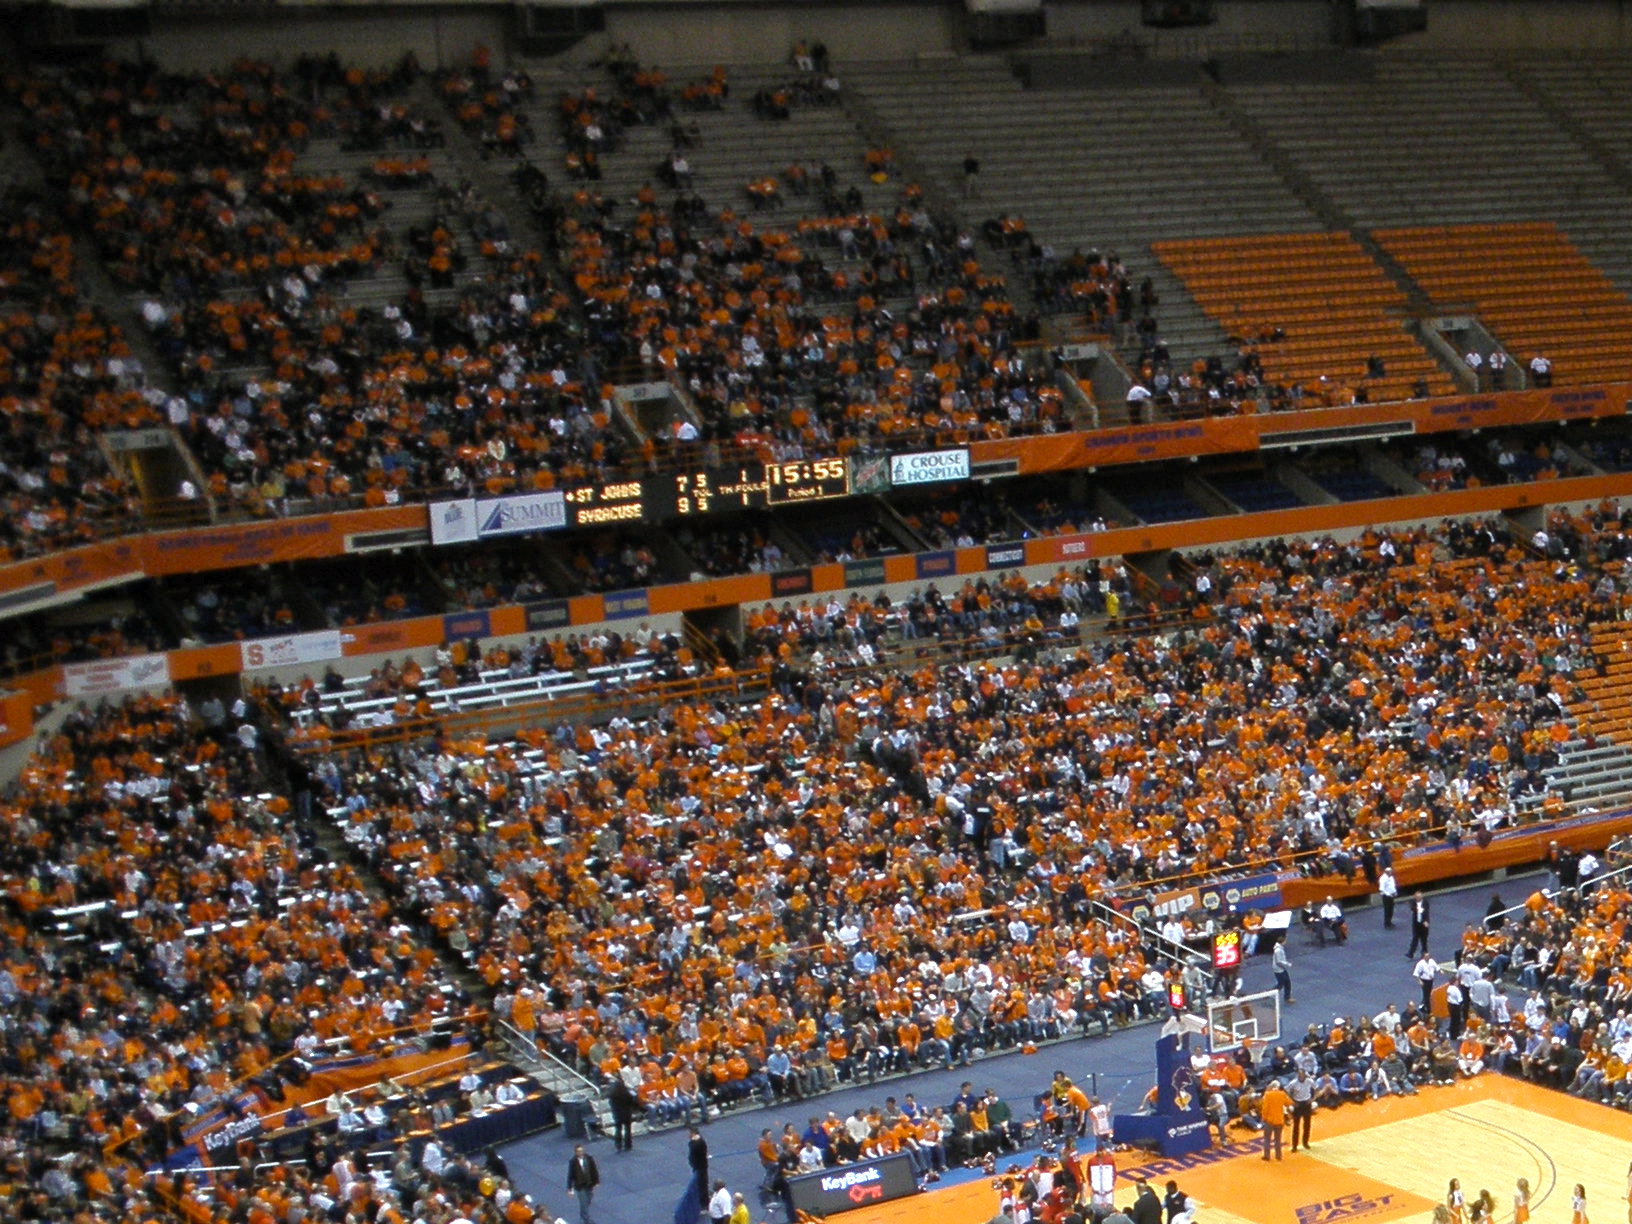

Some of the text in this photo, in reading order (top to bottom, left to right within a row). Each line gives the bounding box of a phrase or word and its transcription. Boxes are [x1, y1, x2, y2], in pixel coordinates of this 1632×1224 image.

[911, 453, 962, 469] CROUSE
[696, 474, 707, 488] 5
[773, 461, 844, 485] 15:55
[907, 466, 968, 482] HOSPITAL
[576, 483, 641, 502] ST JOHNS
[677, 476, 687, 492] 7
[501, 499, 564, 522] SUMMIT
[678, 497, 689, 513] 9
[698, 497, 708, 511] 5
[578, 504, 642, 524] SYRACUSE
[1153, 894, 1194, 917] VIP
[1216, 944, 1238, 965] 35
[821, 1167, 880, 1191] KeyBank
[1295, 1193, 1362, 1217] BIG
